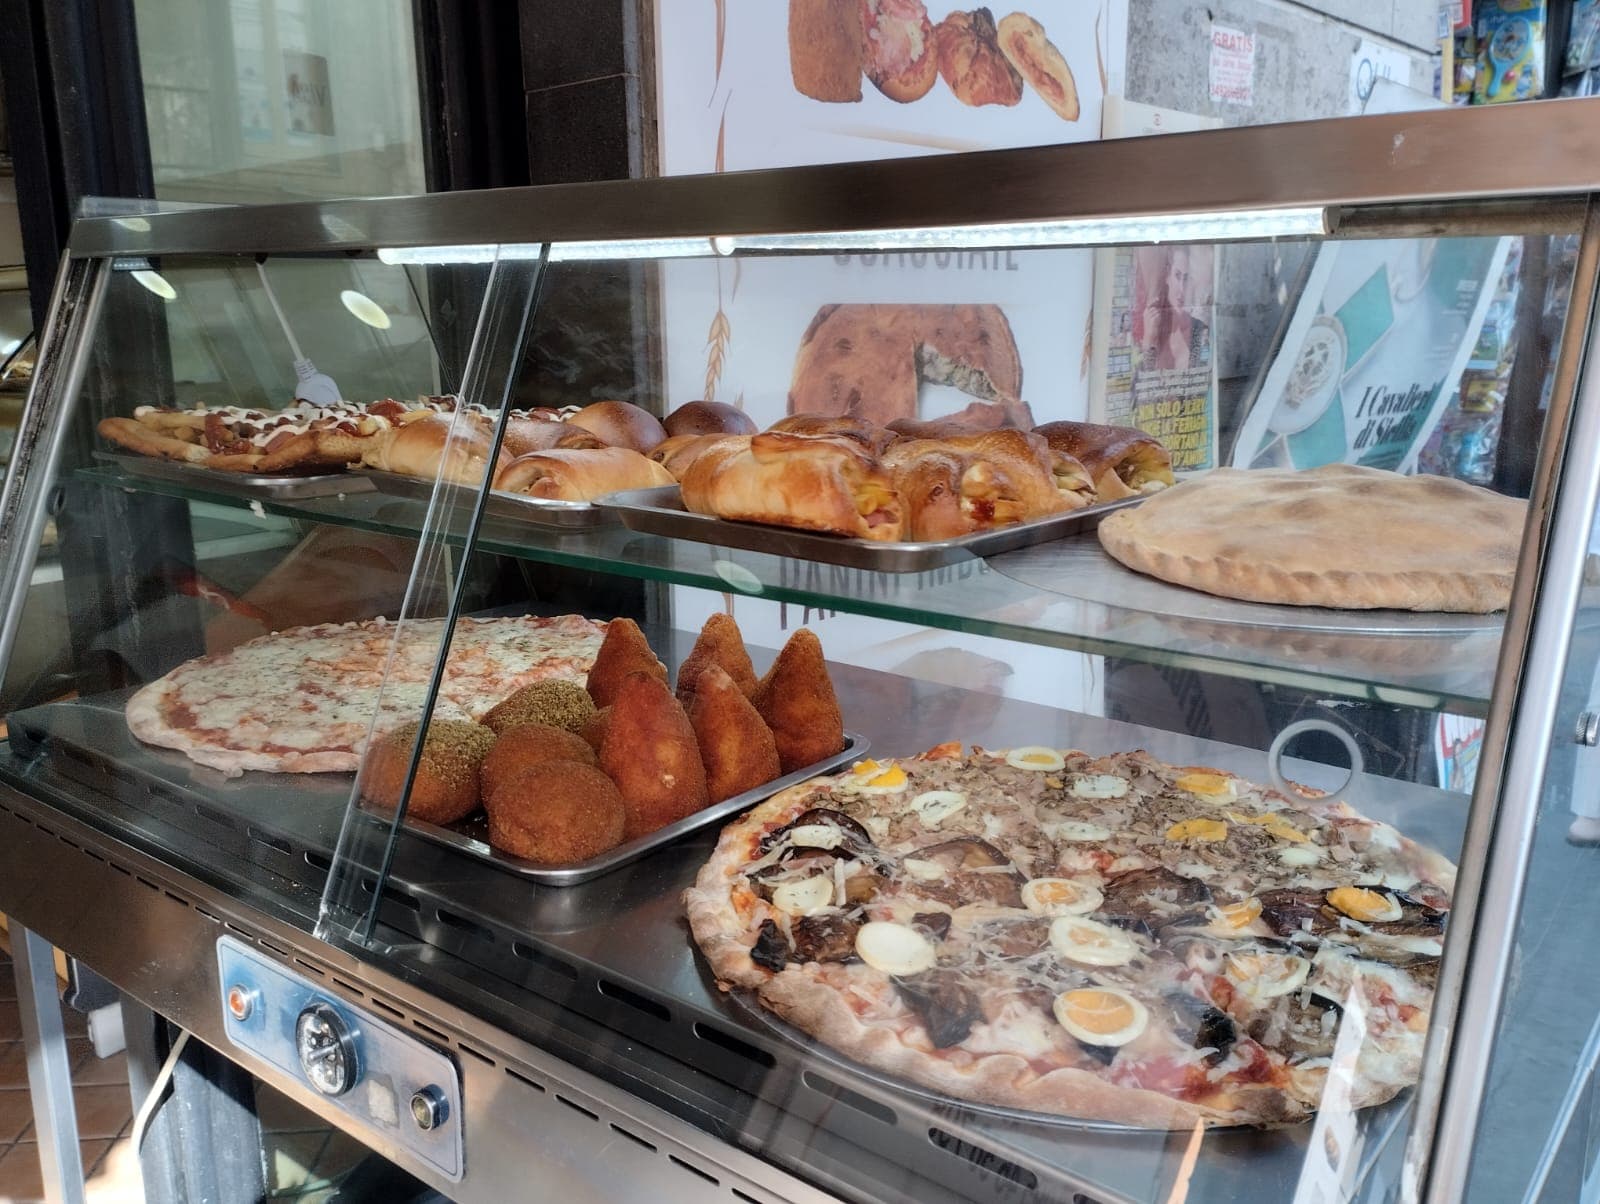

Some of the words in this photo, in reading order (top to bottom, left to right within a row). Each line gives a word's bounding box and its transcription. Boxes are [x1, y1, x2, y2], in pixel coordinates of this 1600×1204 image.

[1212, 31, 1254, 53] GRATIS
[1157, 399, 1181, 419] SOLO
[1355, 386, 1373, 418] I
[1368, 382, 1438, 417] Cavalieri
[1353, 419, 1376, 450] di
